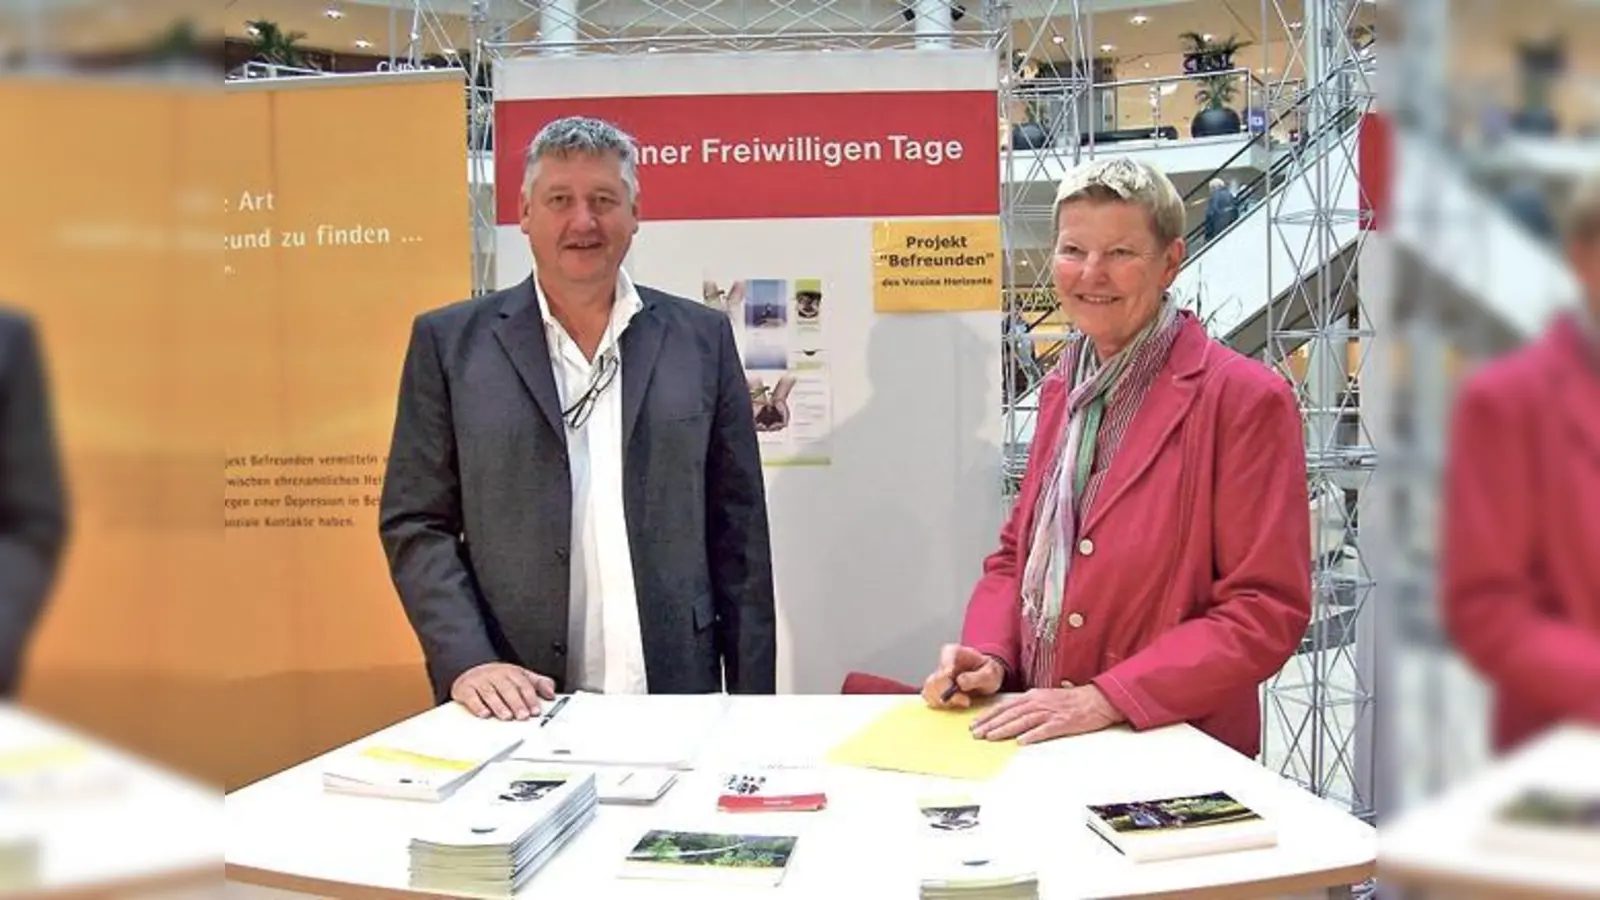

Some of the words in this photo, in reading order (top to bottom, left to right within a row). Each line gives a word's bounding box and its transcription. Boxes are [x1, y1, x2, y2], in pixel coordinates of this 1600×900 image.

[702, 136, 881, 167] Freiwilligen
[887, 134, 963, 165] Tage
[238, 189, 275, 212] Art
[281, 231, 306, 248] zu
[317, 224, 390, 246] finden
[906, 235, 967, 251] Projekt
[251, 453, 314, 466] Befreunden
[226, 476, 271, 487] wischen
[348, 496, 359, 506] in
[264, 517, 314, 527] Kontakte
